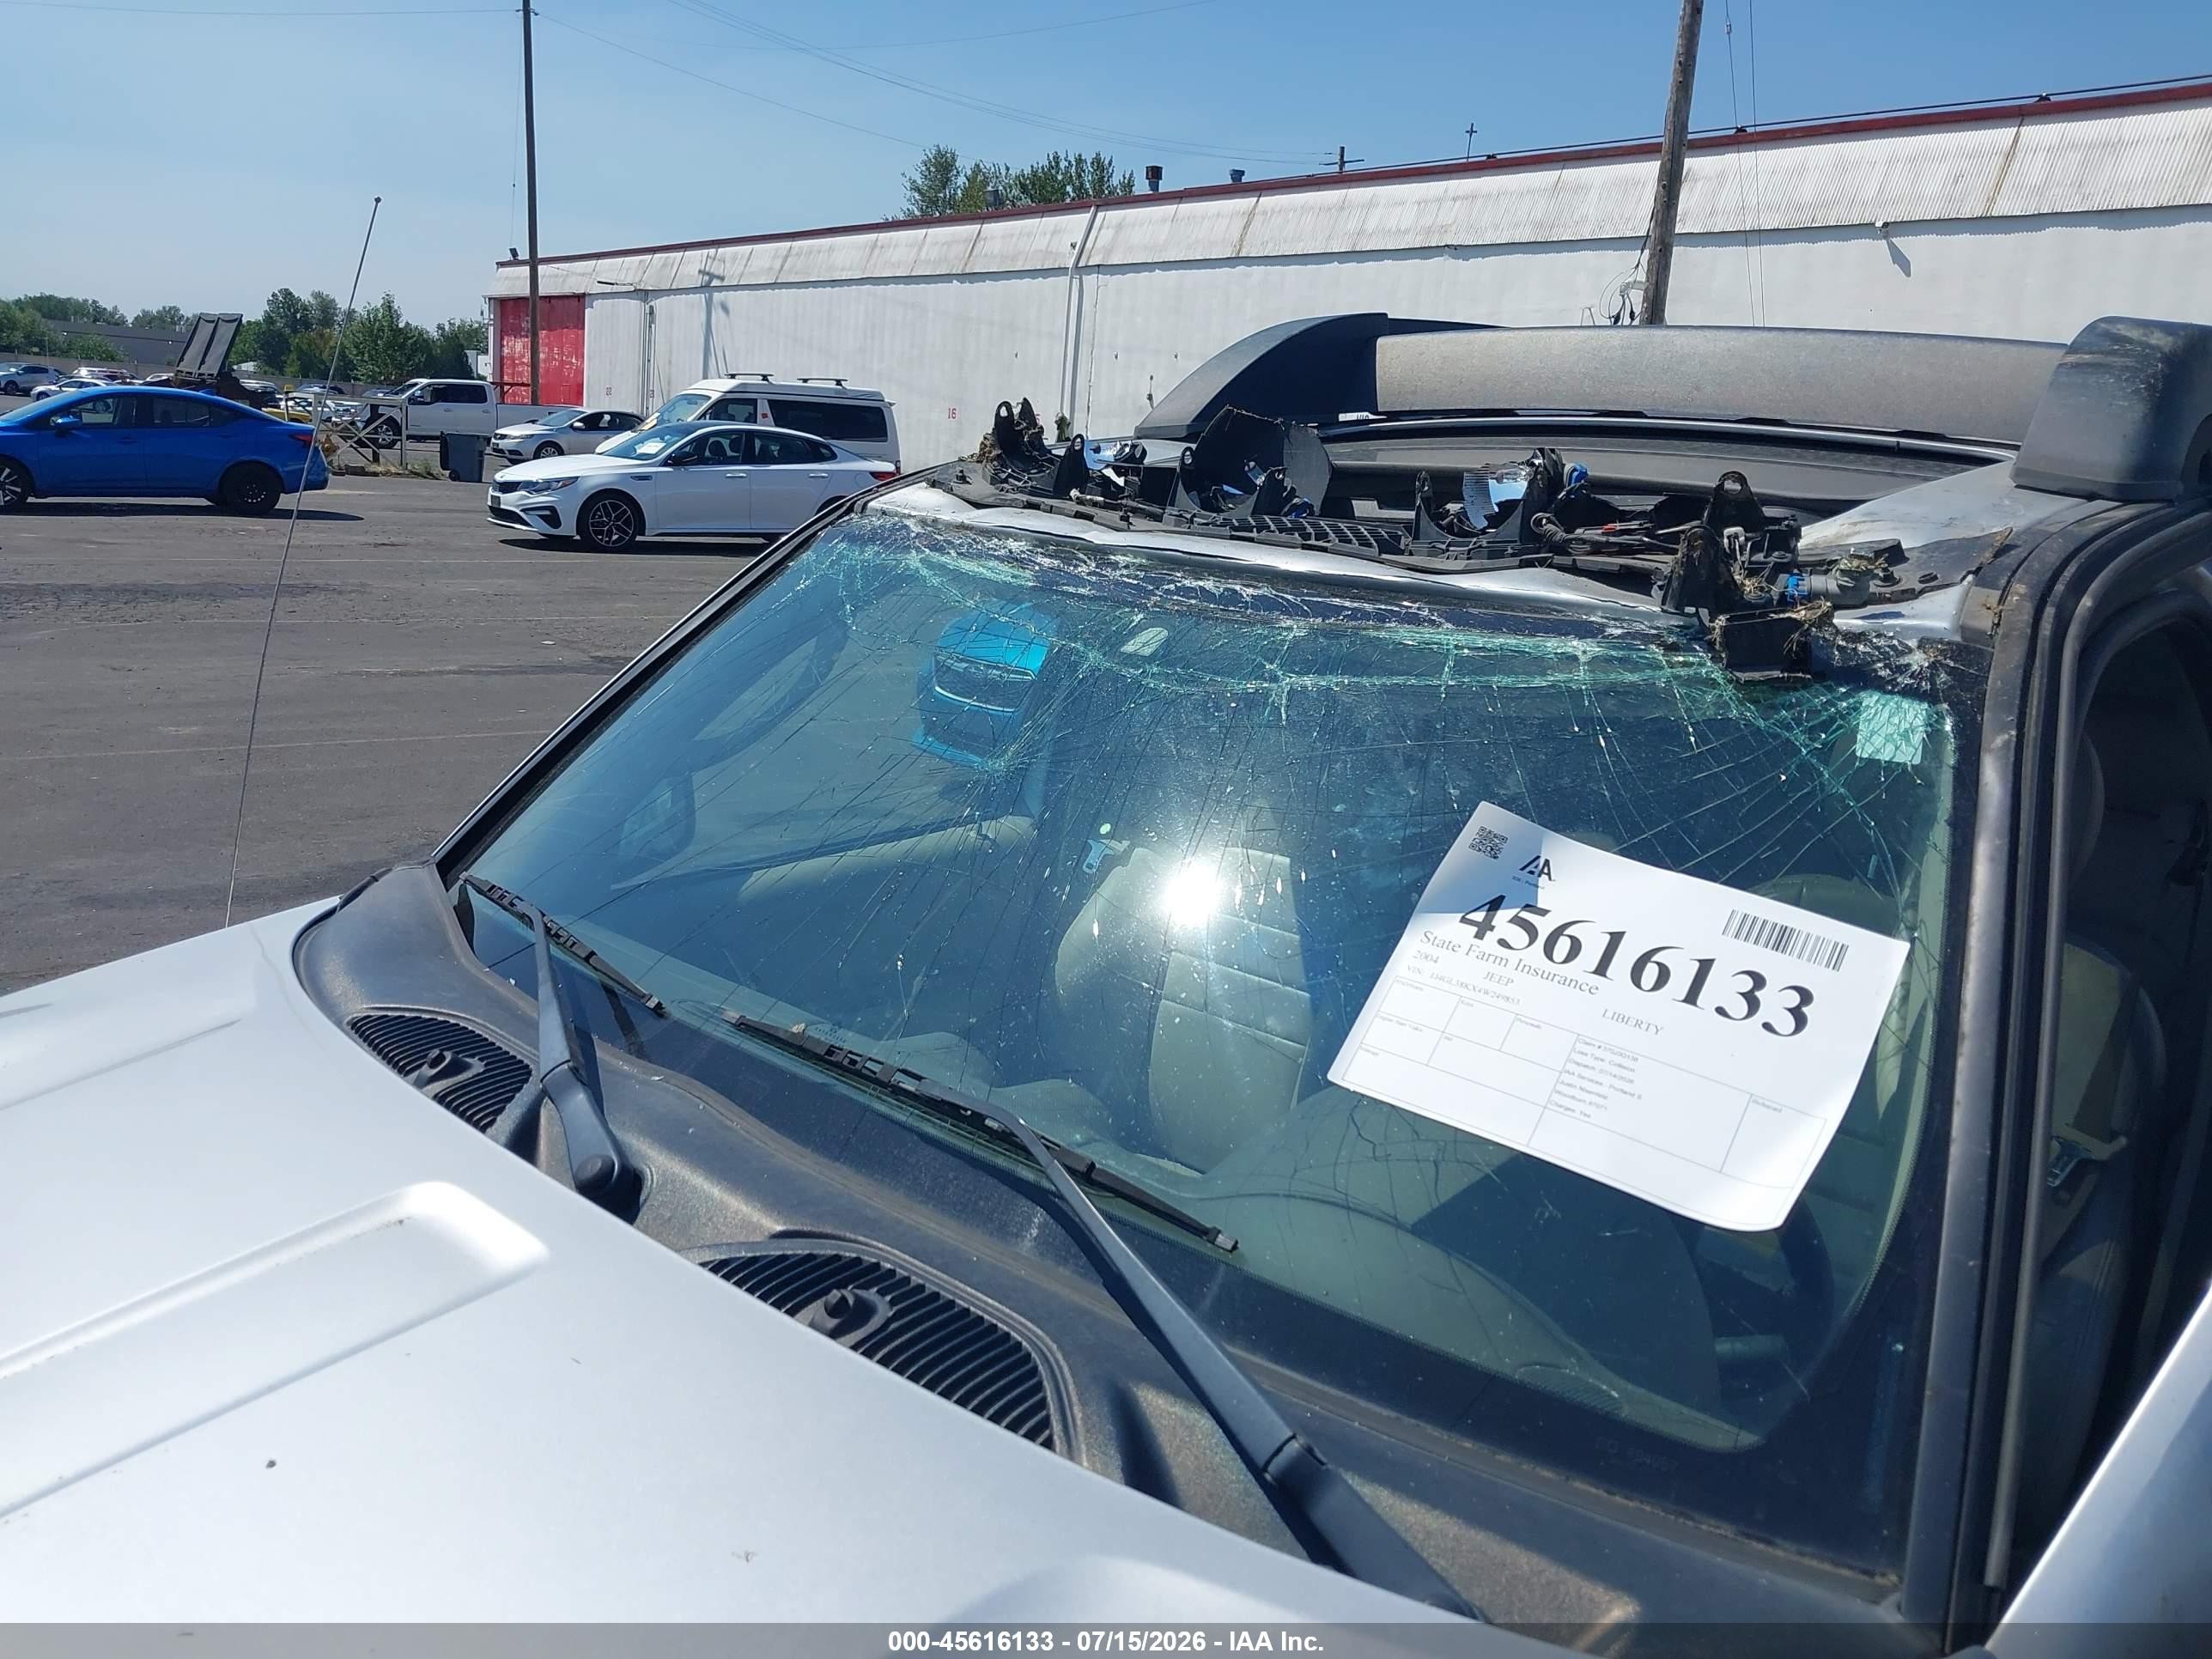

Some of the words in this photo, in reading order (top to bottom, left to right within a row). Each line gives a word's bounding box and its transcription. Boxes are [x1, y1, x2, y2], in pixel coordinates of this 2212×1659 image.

[947, 408, 957, 420] 16
[1413, 950, 1440, 964] 2004
[1420, 930, 1462, 953] State
[1465, 944, 1510, 969] Farm
[1514, 957, 1600, 996] Insurance
[1459, 894, 1814, 1036] 45616133
[1483, 971, 1515, 987] JEEP
[1601, 1008, 1664, 1036] LIBERTY
